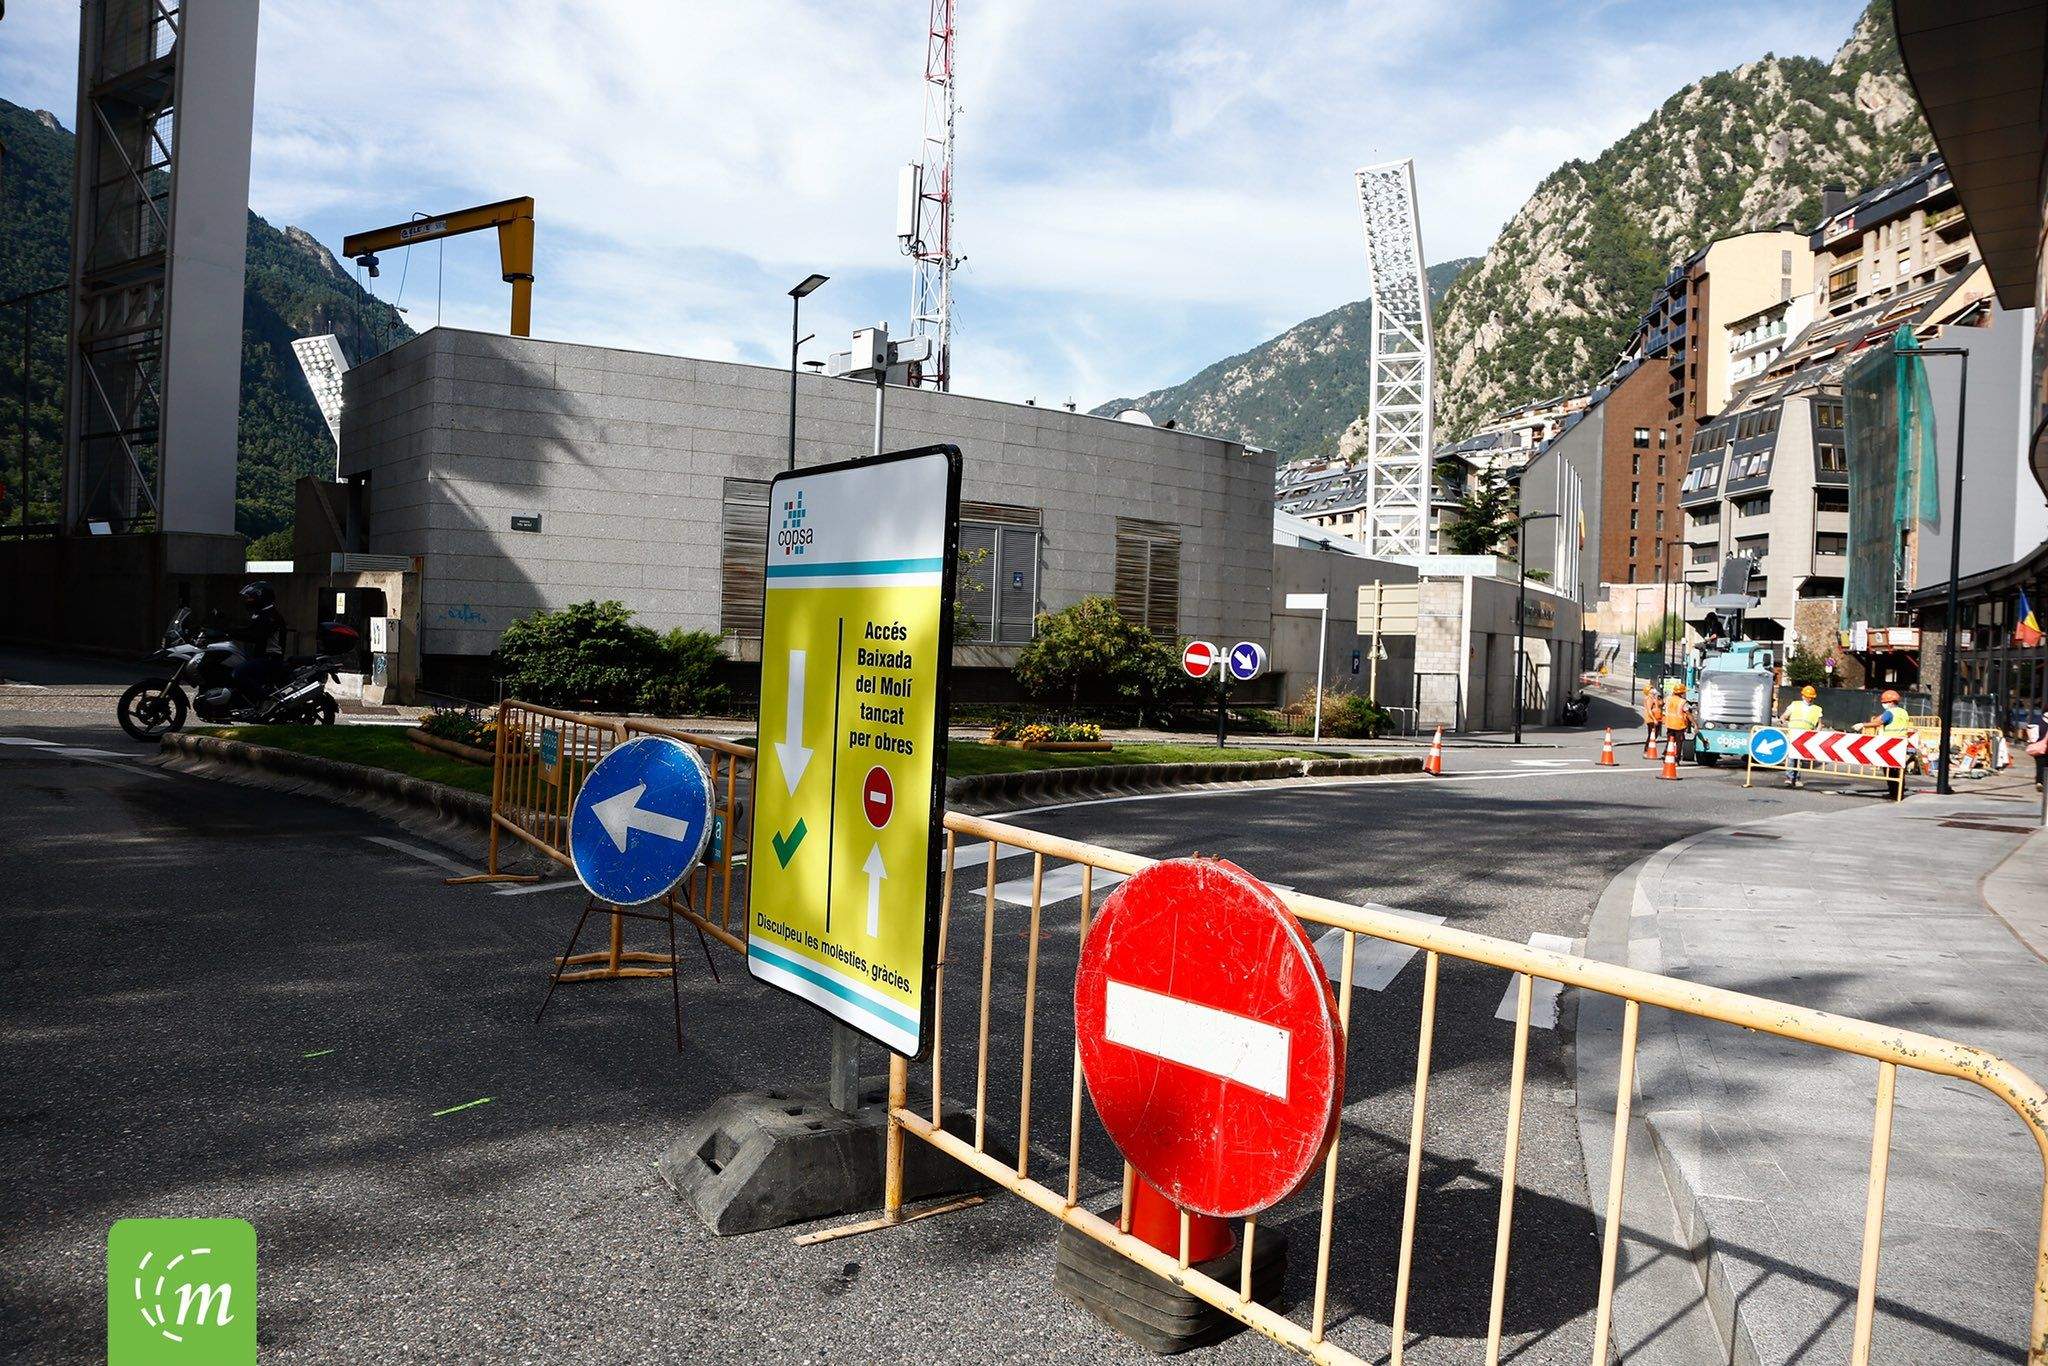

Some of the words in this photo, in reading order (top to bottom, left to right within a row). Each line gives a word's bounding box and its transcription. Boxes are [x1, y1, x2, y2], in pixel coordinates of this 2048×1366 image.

[778, 526, 814, 550] copsa
[865, 621, 907, 641] Accés
[857, 648, 912, 670] Baixada
[856, 675, 876, 694] del
[880, 677, 913, 698] Molí
[860, 702, 904, 726] tancat
[849, 729, 871, 749] per
[875, 731, 914, 756] obres
[757, 912, 803, 944] Disculpeu
[805, 931, 819, 950] les
[821, 941, 869, 976] molèsties,
[871, 963, 913, 994] gràcies.
